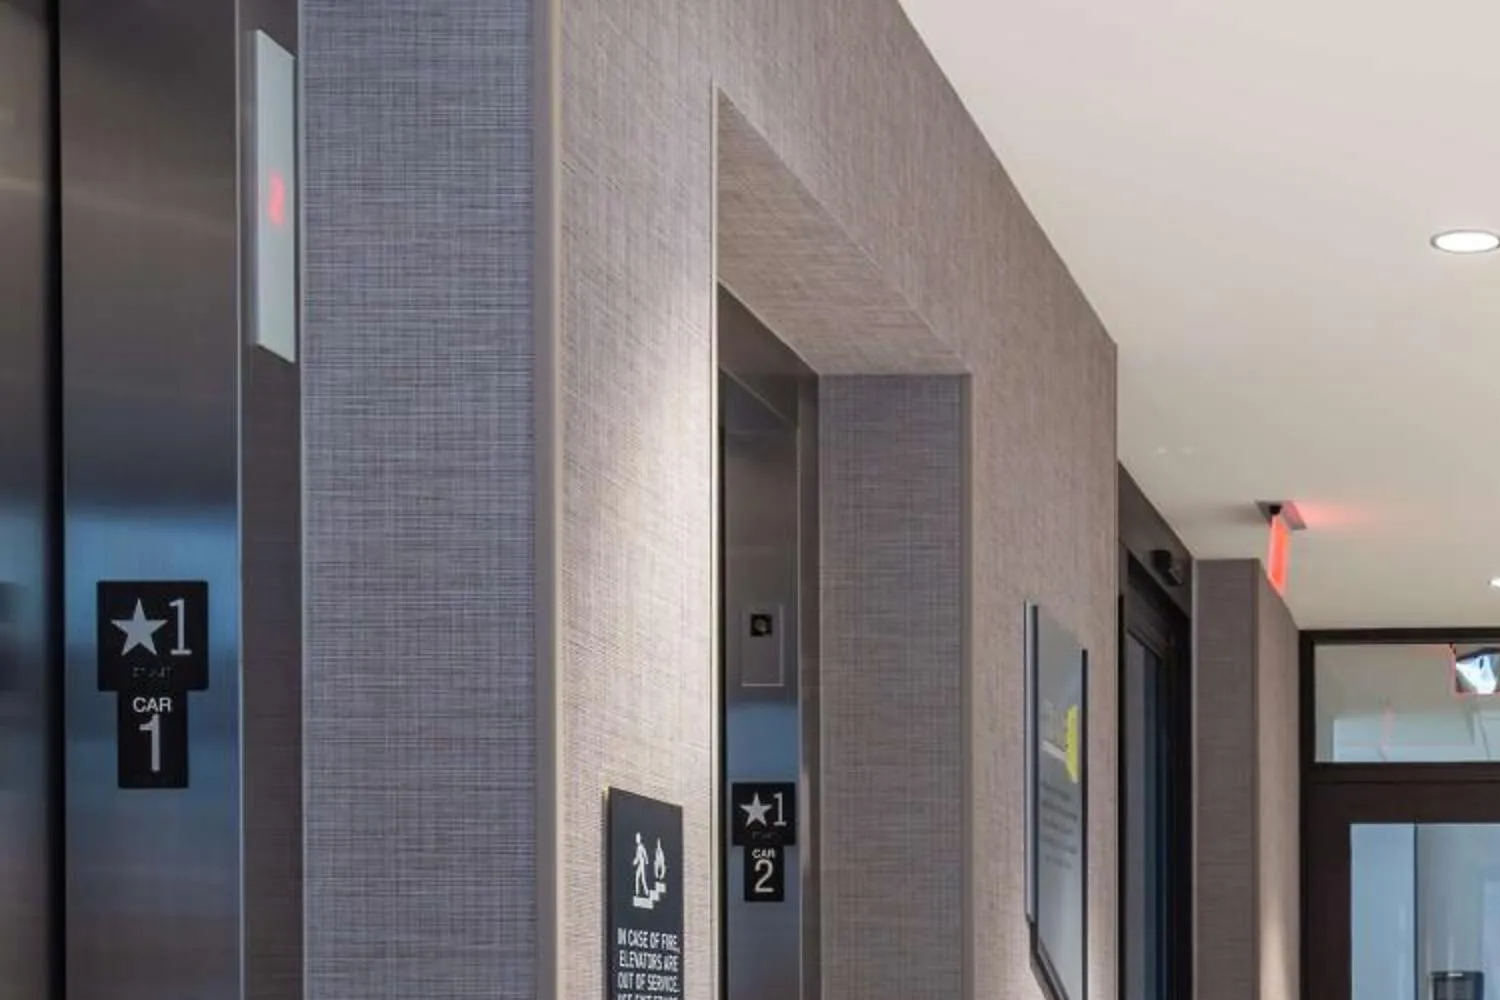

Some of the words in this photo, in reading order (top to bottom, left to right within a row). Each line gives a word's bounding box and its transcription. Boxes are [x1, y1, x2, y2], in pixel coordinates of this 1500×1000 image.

[168, 597, 193, 656] 1
[132, 697, 172, 713] CAR
[139, 714, 161, 773] 1
[772, 791, 788, 827] 1
[751, 847, 776, 859] CAR
[753, 858, 775, 893] 2
[617, 927, 627, 945] IN
[628, 928, 649, 949] CASE
[650, 931, 661, 949] OF
[619, 950, 663, 971] ELEVATORS
[664, 954, 679, 973] ARE
[617, 971, 634, 989] OUT
[635, 973, 646, 990] OF
[647, 973, 681, 993] SERVICE.
